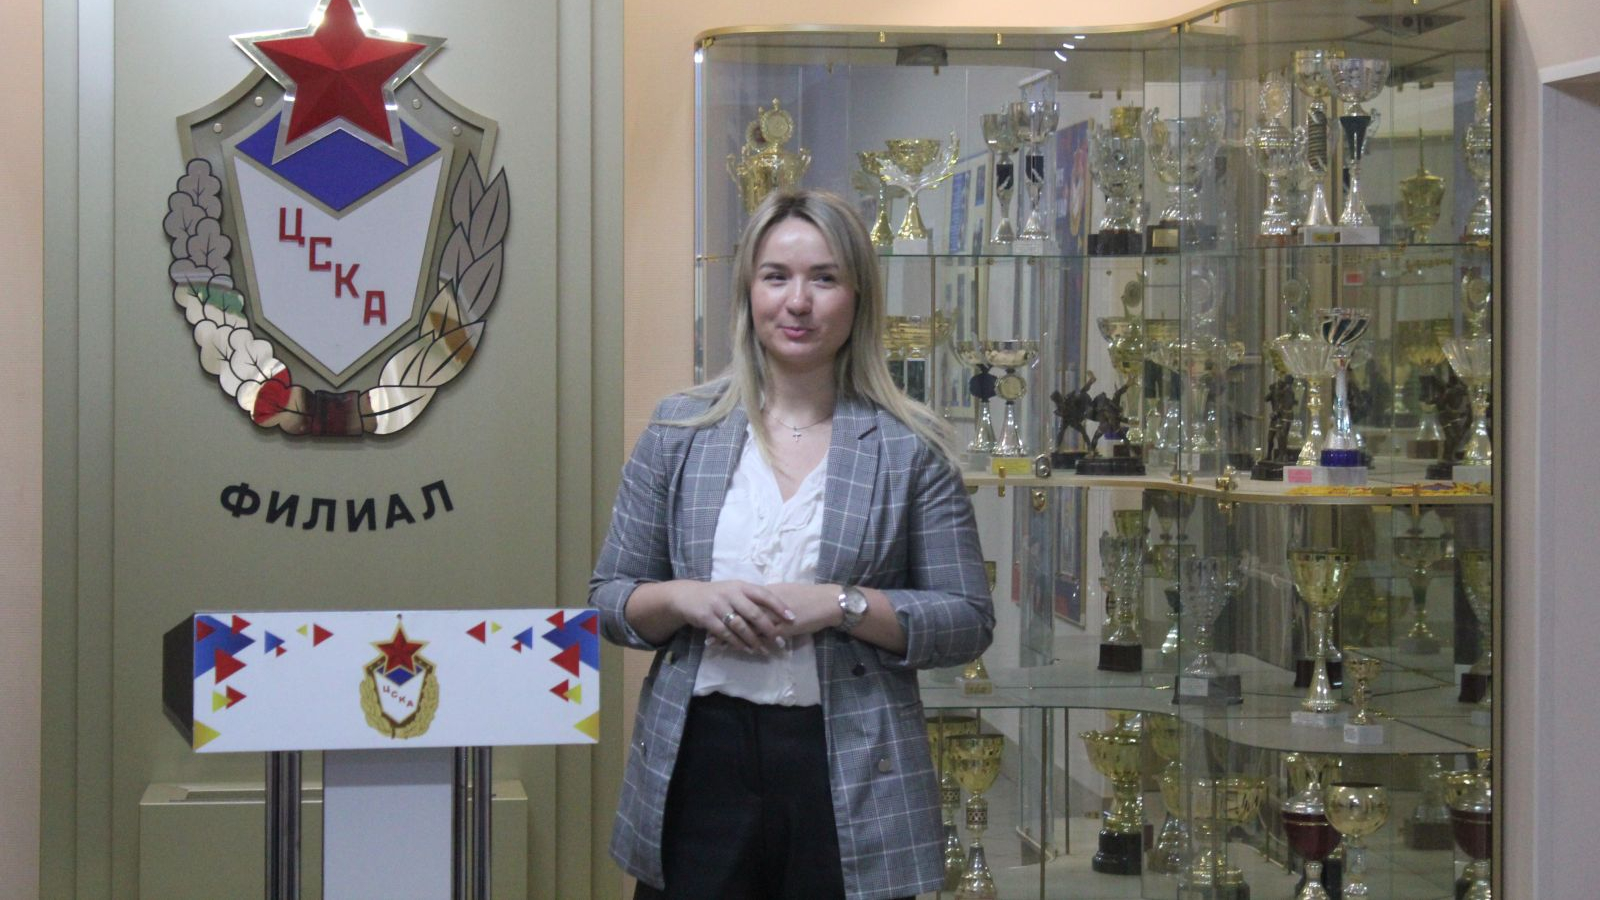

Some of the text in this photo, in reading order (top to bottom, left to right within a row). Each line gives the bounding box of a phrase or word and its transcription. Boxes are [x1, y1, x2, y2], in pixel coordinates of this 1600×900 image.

[278, 207, 387, 326] ЦСКА
[220, 479, 454, 532] ФИЛИАЛ
[383, 685, 414, 707] ЦСКА
